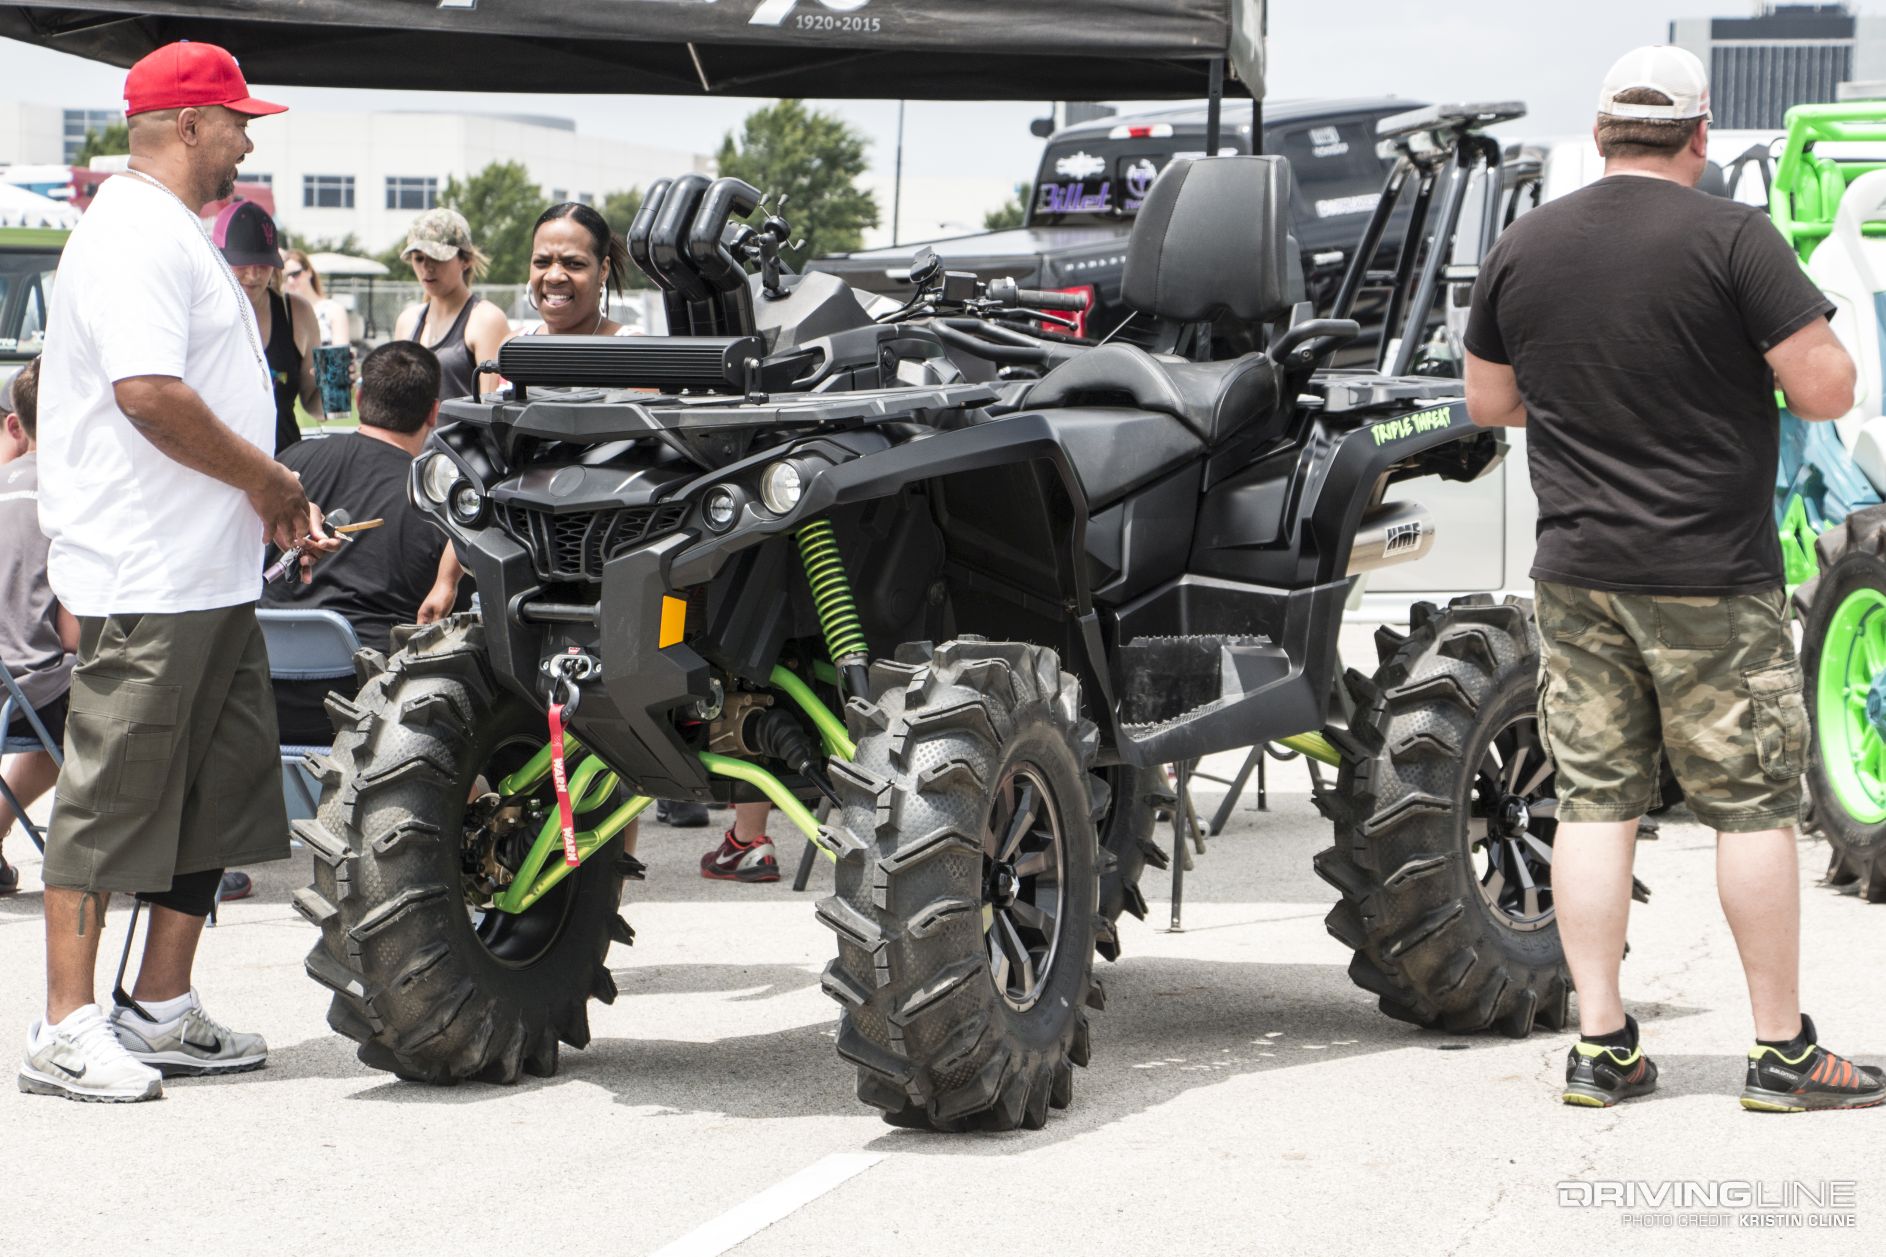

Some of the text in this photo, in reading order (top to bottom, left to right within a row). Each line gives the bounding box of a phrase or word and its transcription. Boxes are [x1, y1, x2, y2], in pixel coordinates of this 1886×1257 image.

[1039, 181, 1112, 213] Billet
[1371, 406, 1451, 446] TRIPLE THREAT
[553, 757, 567, 792] WARN
[563, 827, 577, 861] WARN
